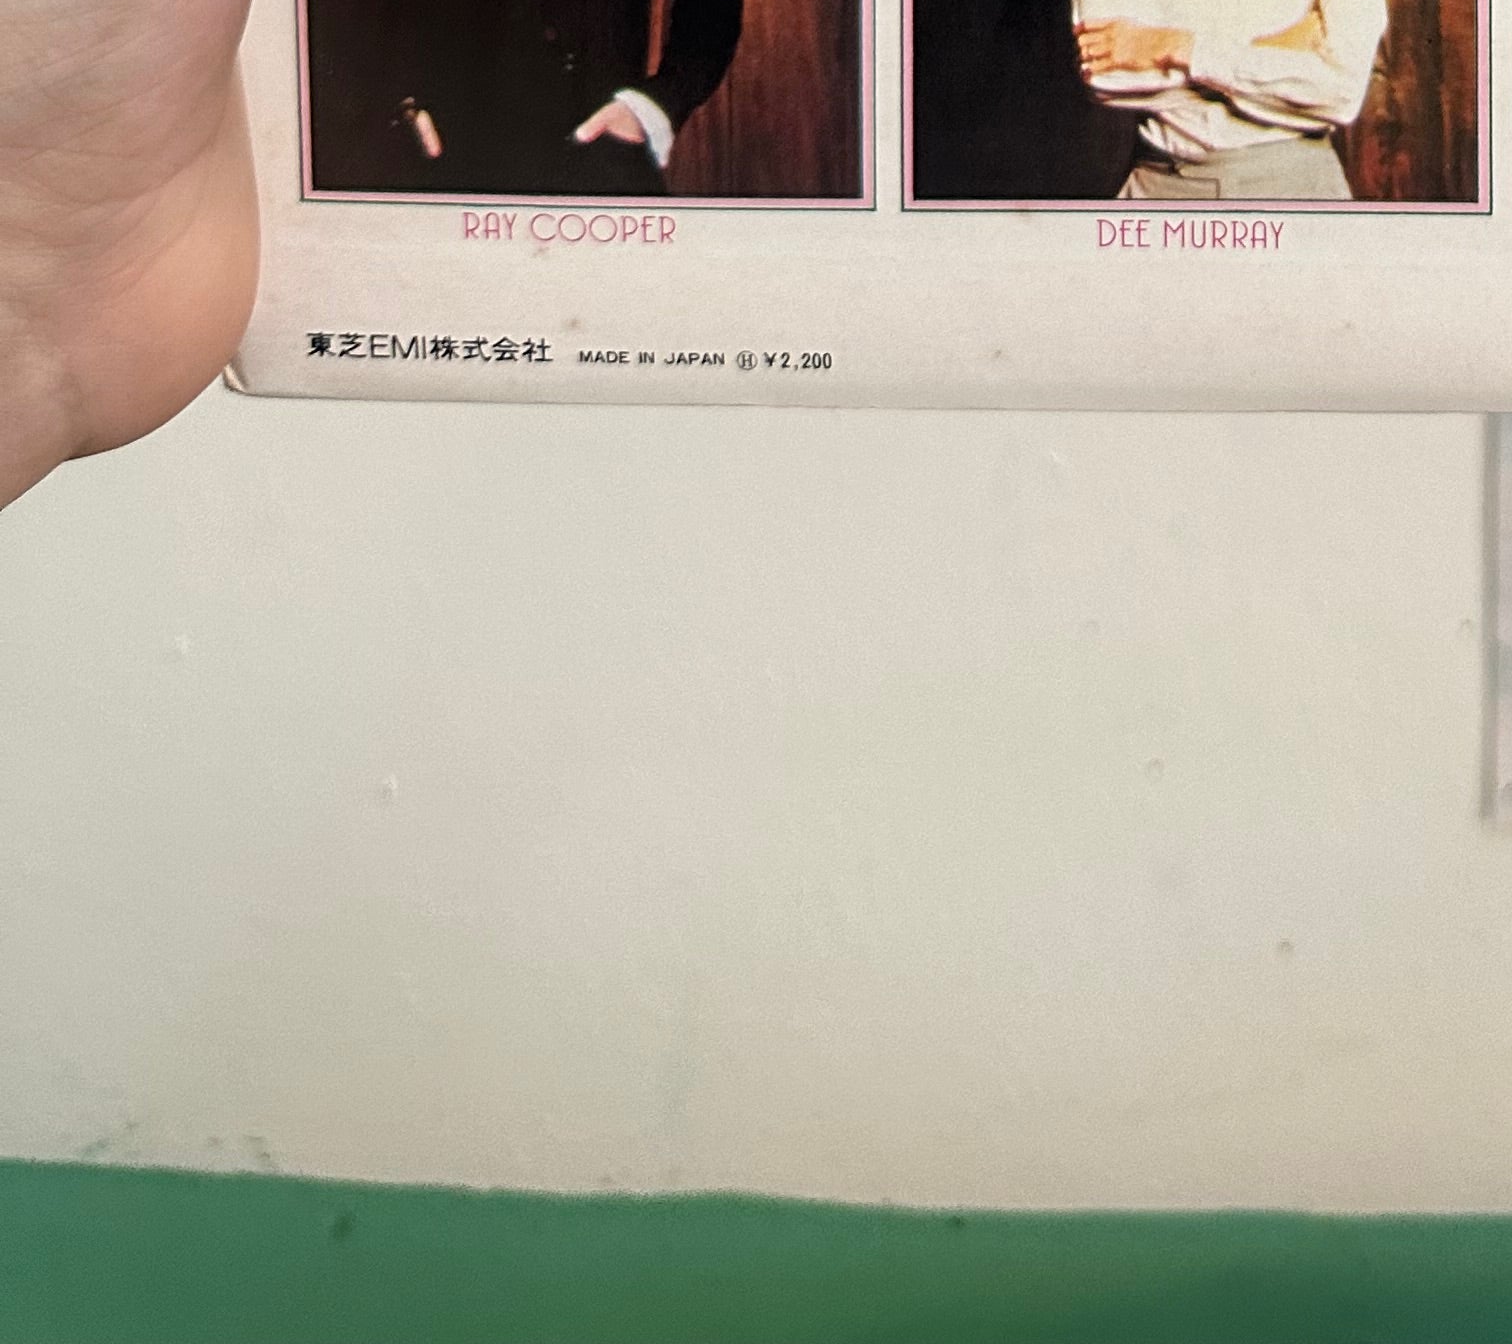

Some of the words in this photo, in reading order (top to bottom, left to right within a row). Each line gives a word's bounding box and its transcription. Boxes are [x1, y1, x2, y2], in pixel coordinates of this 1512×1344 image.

[463, 212, 517, 240] RAY
[529, 212, 678, 243] COOPER
[1097, 219, 1150, 247] DEE
[1163, 220, 1284, 249] MURRAY
[307, 333, 552, 362] 東芝EMI株式会社
[579, 351, 629, 364] MADE
[638, 352, 655, 364] IN
[664, 353, 725, 365] JAPAN
[764, 352, 832, 370] ¥2,200
